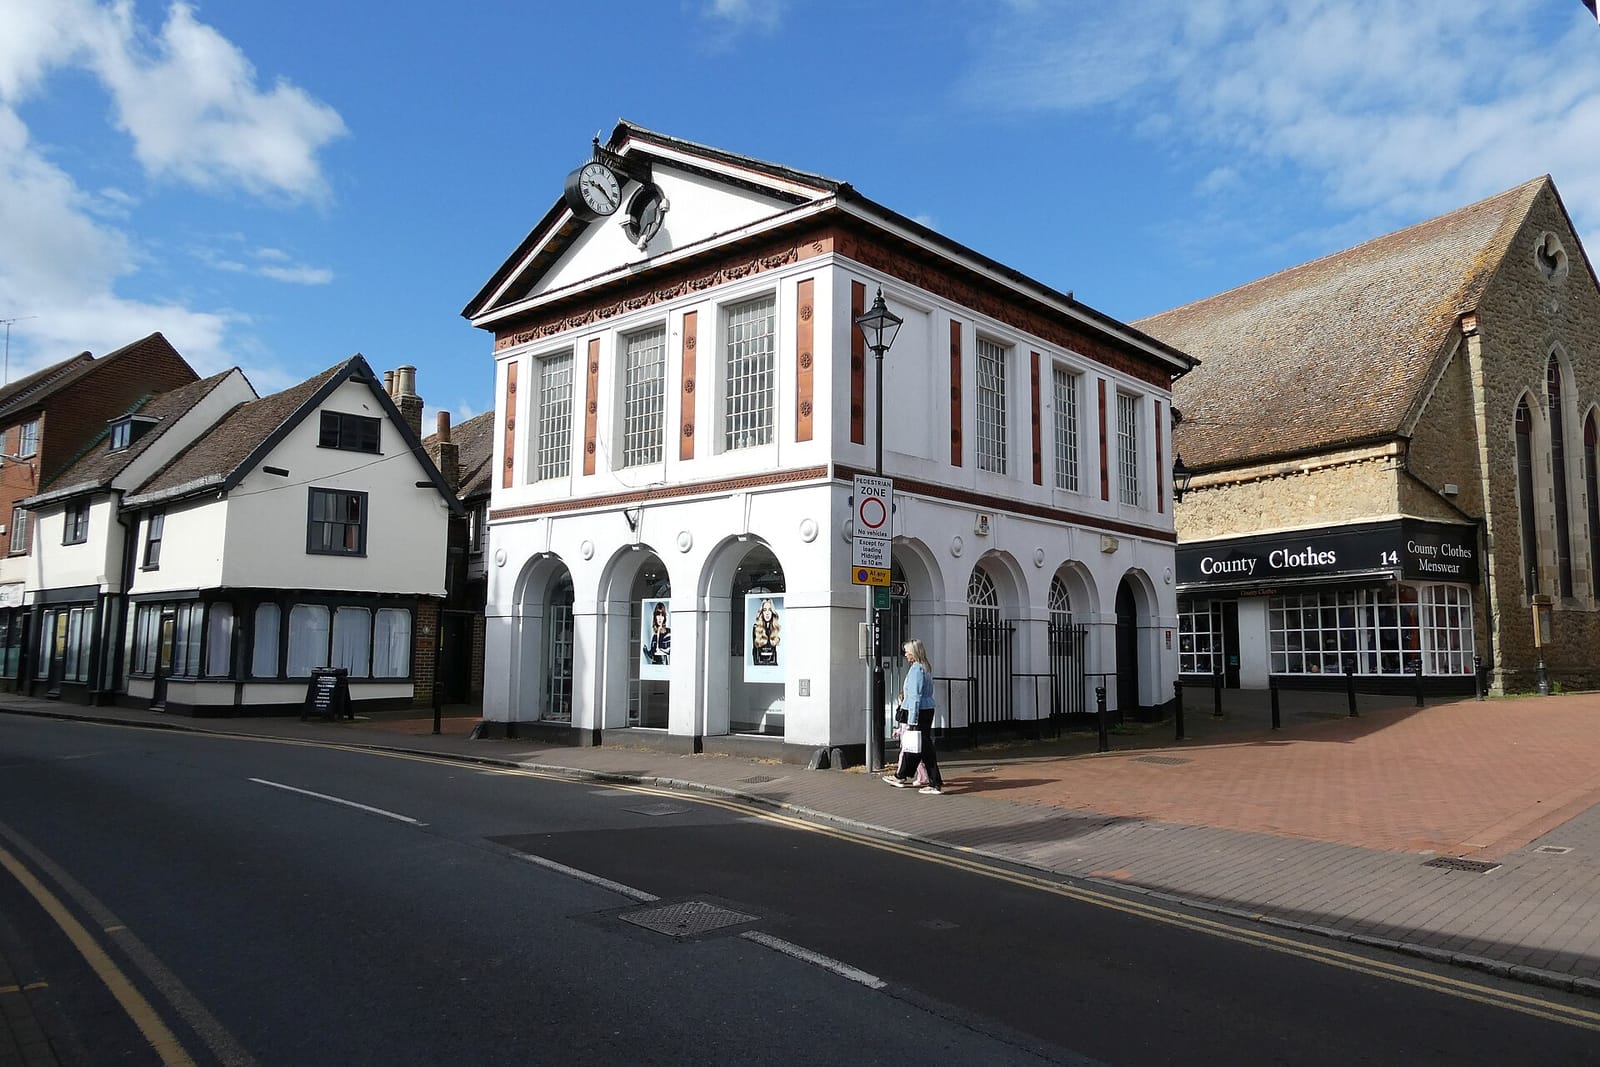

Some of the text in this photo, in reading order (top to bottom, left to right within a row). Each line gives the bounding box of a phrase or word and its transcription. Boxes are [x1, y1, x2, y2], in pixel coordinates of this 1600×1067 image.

[856, 477, 891, 487] PEDESTRIAN
[861, 486, 886, 497] ZONE
[859, 539, 877, 547] Except
[863, 546, 881, 554] loading
[1407, 540, 1472, 559] County Clothes
[861, 552, 883, 560] Midnight
[1200, 555, 1257, 576] County
[1269, 546, 1336, 569] Clothes
[1418, 557, 1460, 574] Menswear
